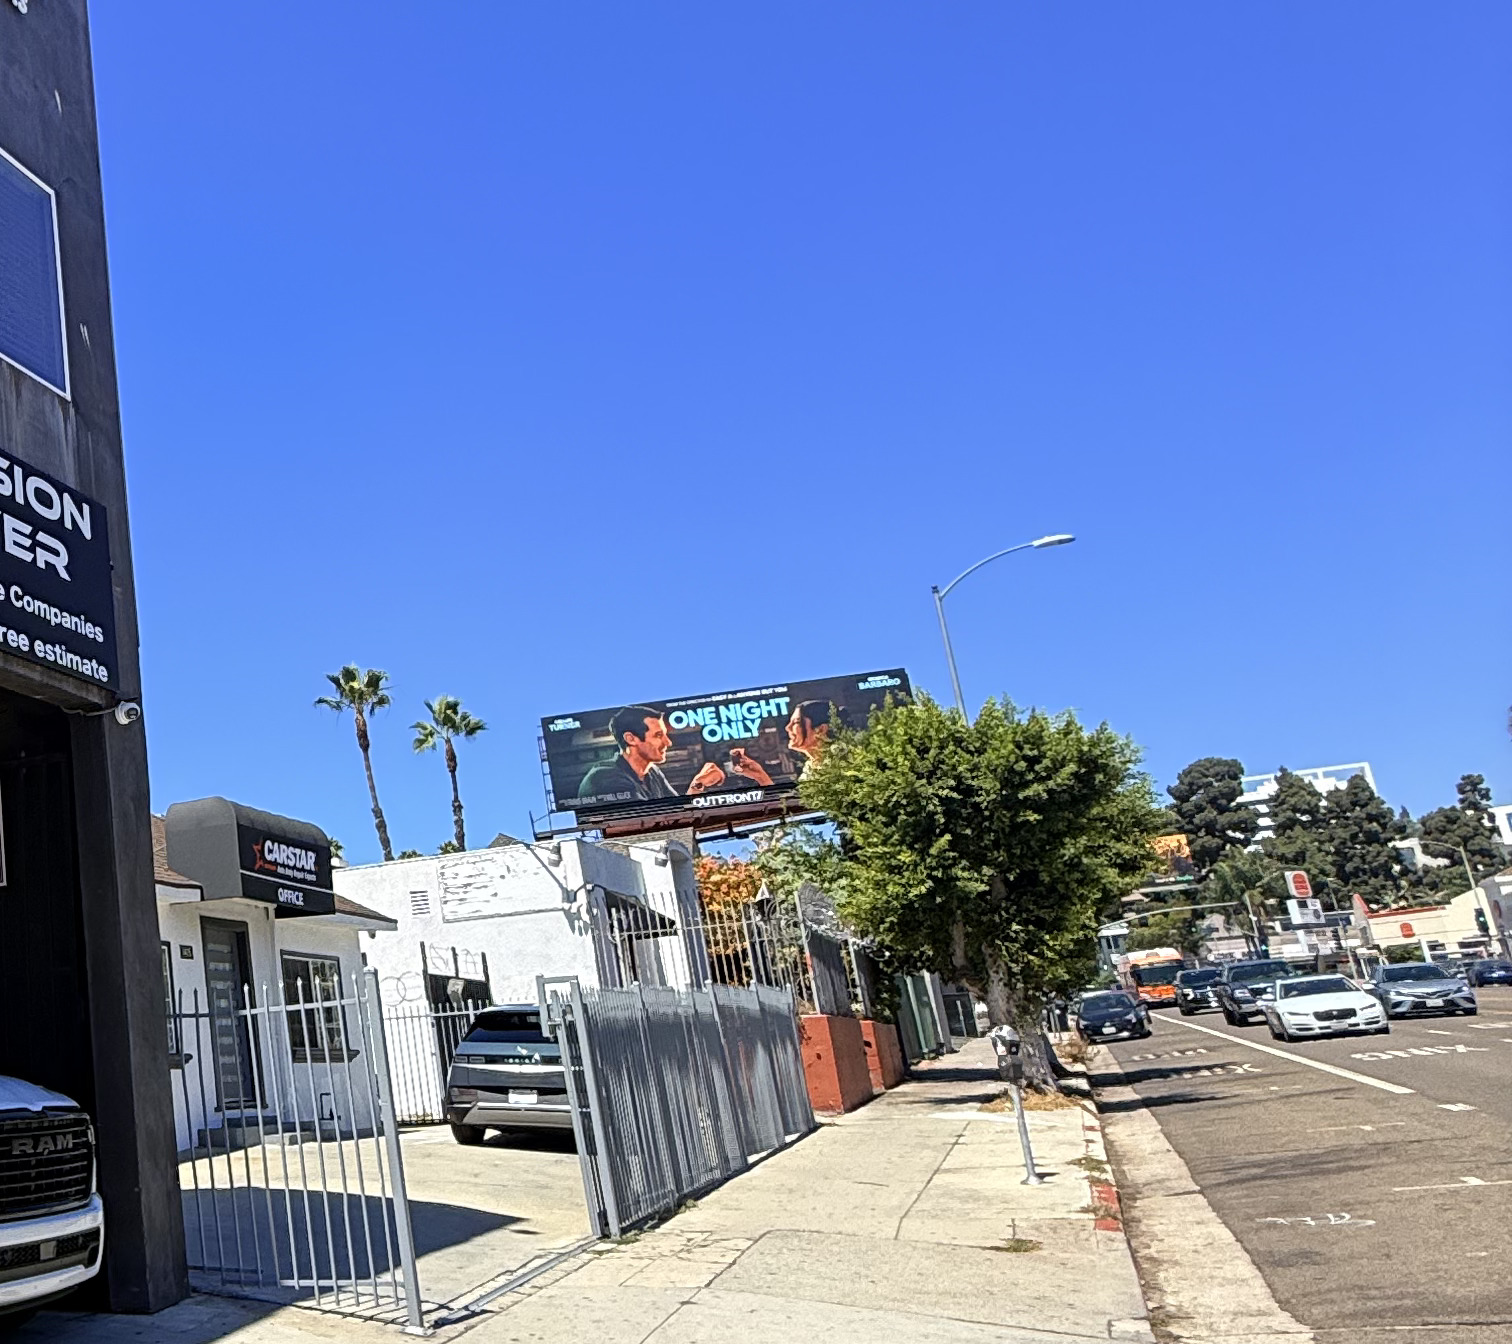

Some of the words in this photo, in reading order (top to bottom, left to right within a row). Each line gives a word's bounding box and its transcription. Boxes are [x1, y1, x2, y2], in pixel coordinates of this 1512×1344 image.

[9, 585, 104, 643] Companies
[33, 639, 109, 683] estimate
[668, 708, 717, 730] ONE
[719, 697, 790, 723] NIGHT
[702, 718, 762, 743] ONLY
[264, 840, 315, 871] CARSTAR
[278, 887, 304, 906] OFFICE
[11, 1133, 73, 1154] RAM
